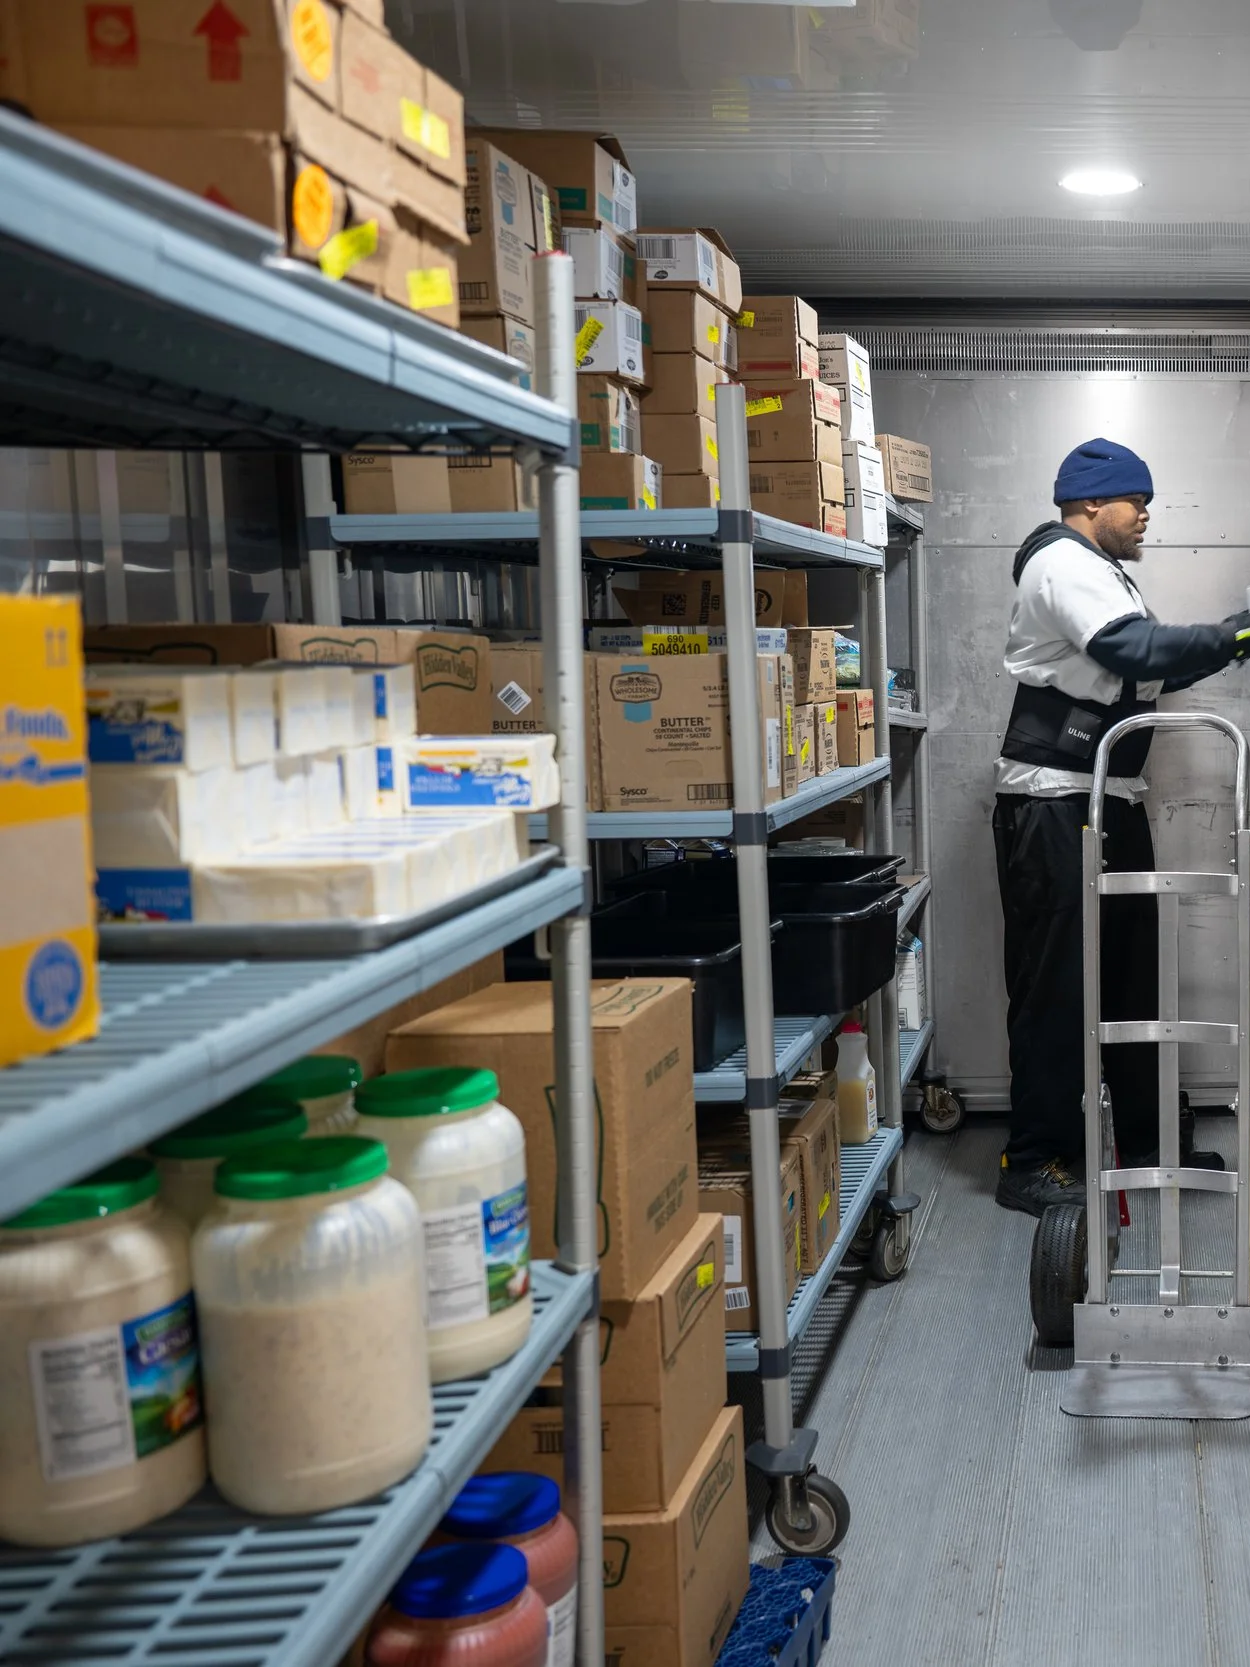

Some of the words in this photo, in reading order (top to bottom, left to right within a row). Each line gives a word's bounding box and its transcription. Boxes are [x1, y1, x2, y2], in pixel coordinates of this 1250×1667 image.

[666, 634, 684, 644] 690
[651, 643, 701, 656] 5049410
[615, 686, 658, 696] WHOLESOME
[492, 720, 537, 730] BUTTER
[660, 716, 704, 728] BUTTER
[1068, 727, 1091, 741] ULINE
[619, 786, 648, 797] Sysco
